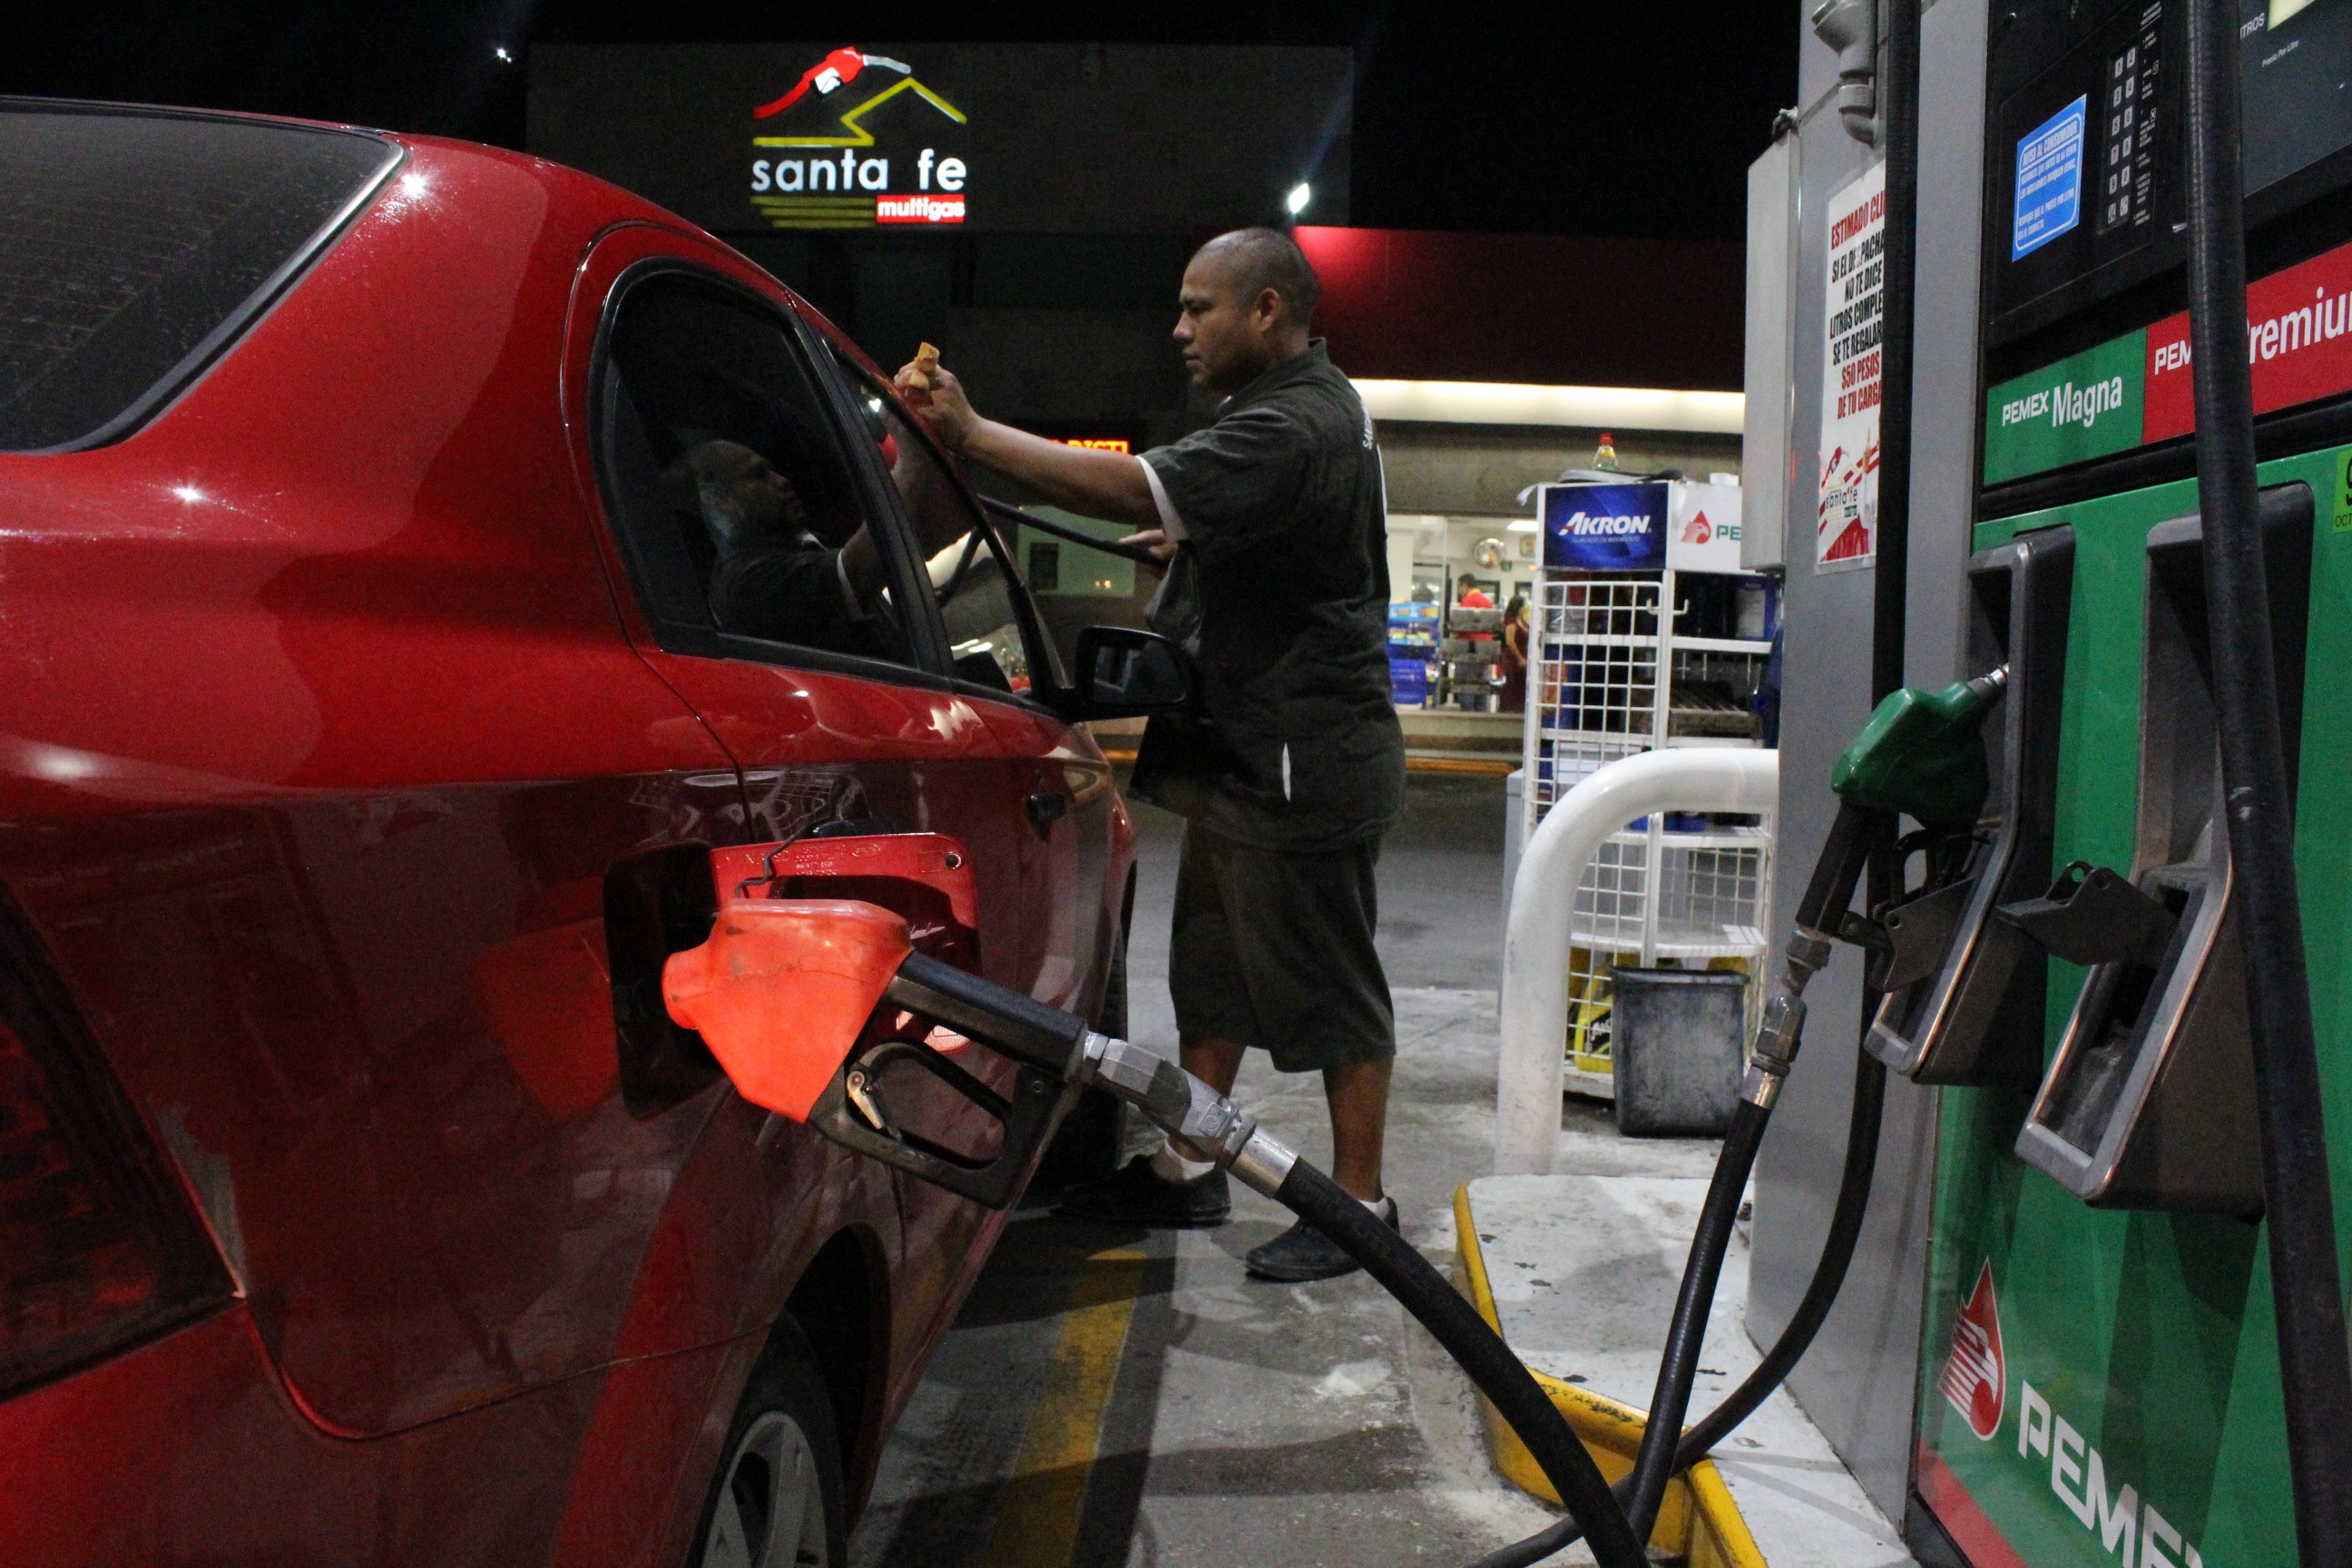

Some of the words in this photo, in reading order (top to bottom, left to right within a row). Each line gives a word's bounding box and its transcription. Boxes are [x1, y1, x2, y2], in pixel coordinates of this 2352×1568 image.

[751, 149, 888, 191] santa
[917, 149, 967, 191] fe
[877, 197, 965, 220] multigas
[1830, 201, 1869, 250] ESTIMADO
[1832, 258, 1839, 283] SI
[1840, 253, 1848, 277] EL
[1845, 278, 1855, 303] NO
[1856, 270, 1864, 295] TE
[1864, 259, 1882, 290] DICE
[1829, 307, 1853, 339] LITROS
[2247, 286, 2352, 364] remiu
[1833, 339, 1841, 366] SE
[1842, 336, 1850, 359] TE
[1841, 362, 1857, 391] $50
[1857, 350, 1880, 382] PESOS
[1838, 395, 1847, 420] DE
[1847, 391, 1857, 416] TU
[2002, 390, 2049, 426] PEMEX
[2052, 376, 2122, 427] Magna
[1558, 511, 1651, 536] AKRON
